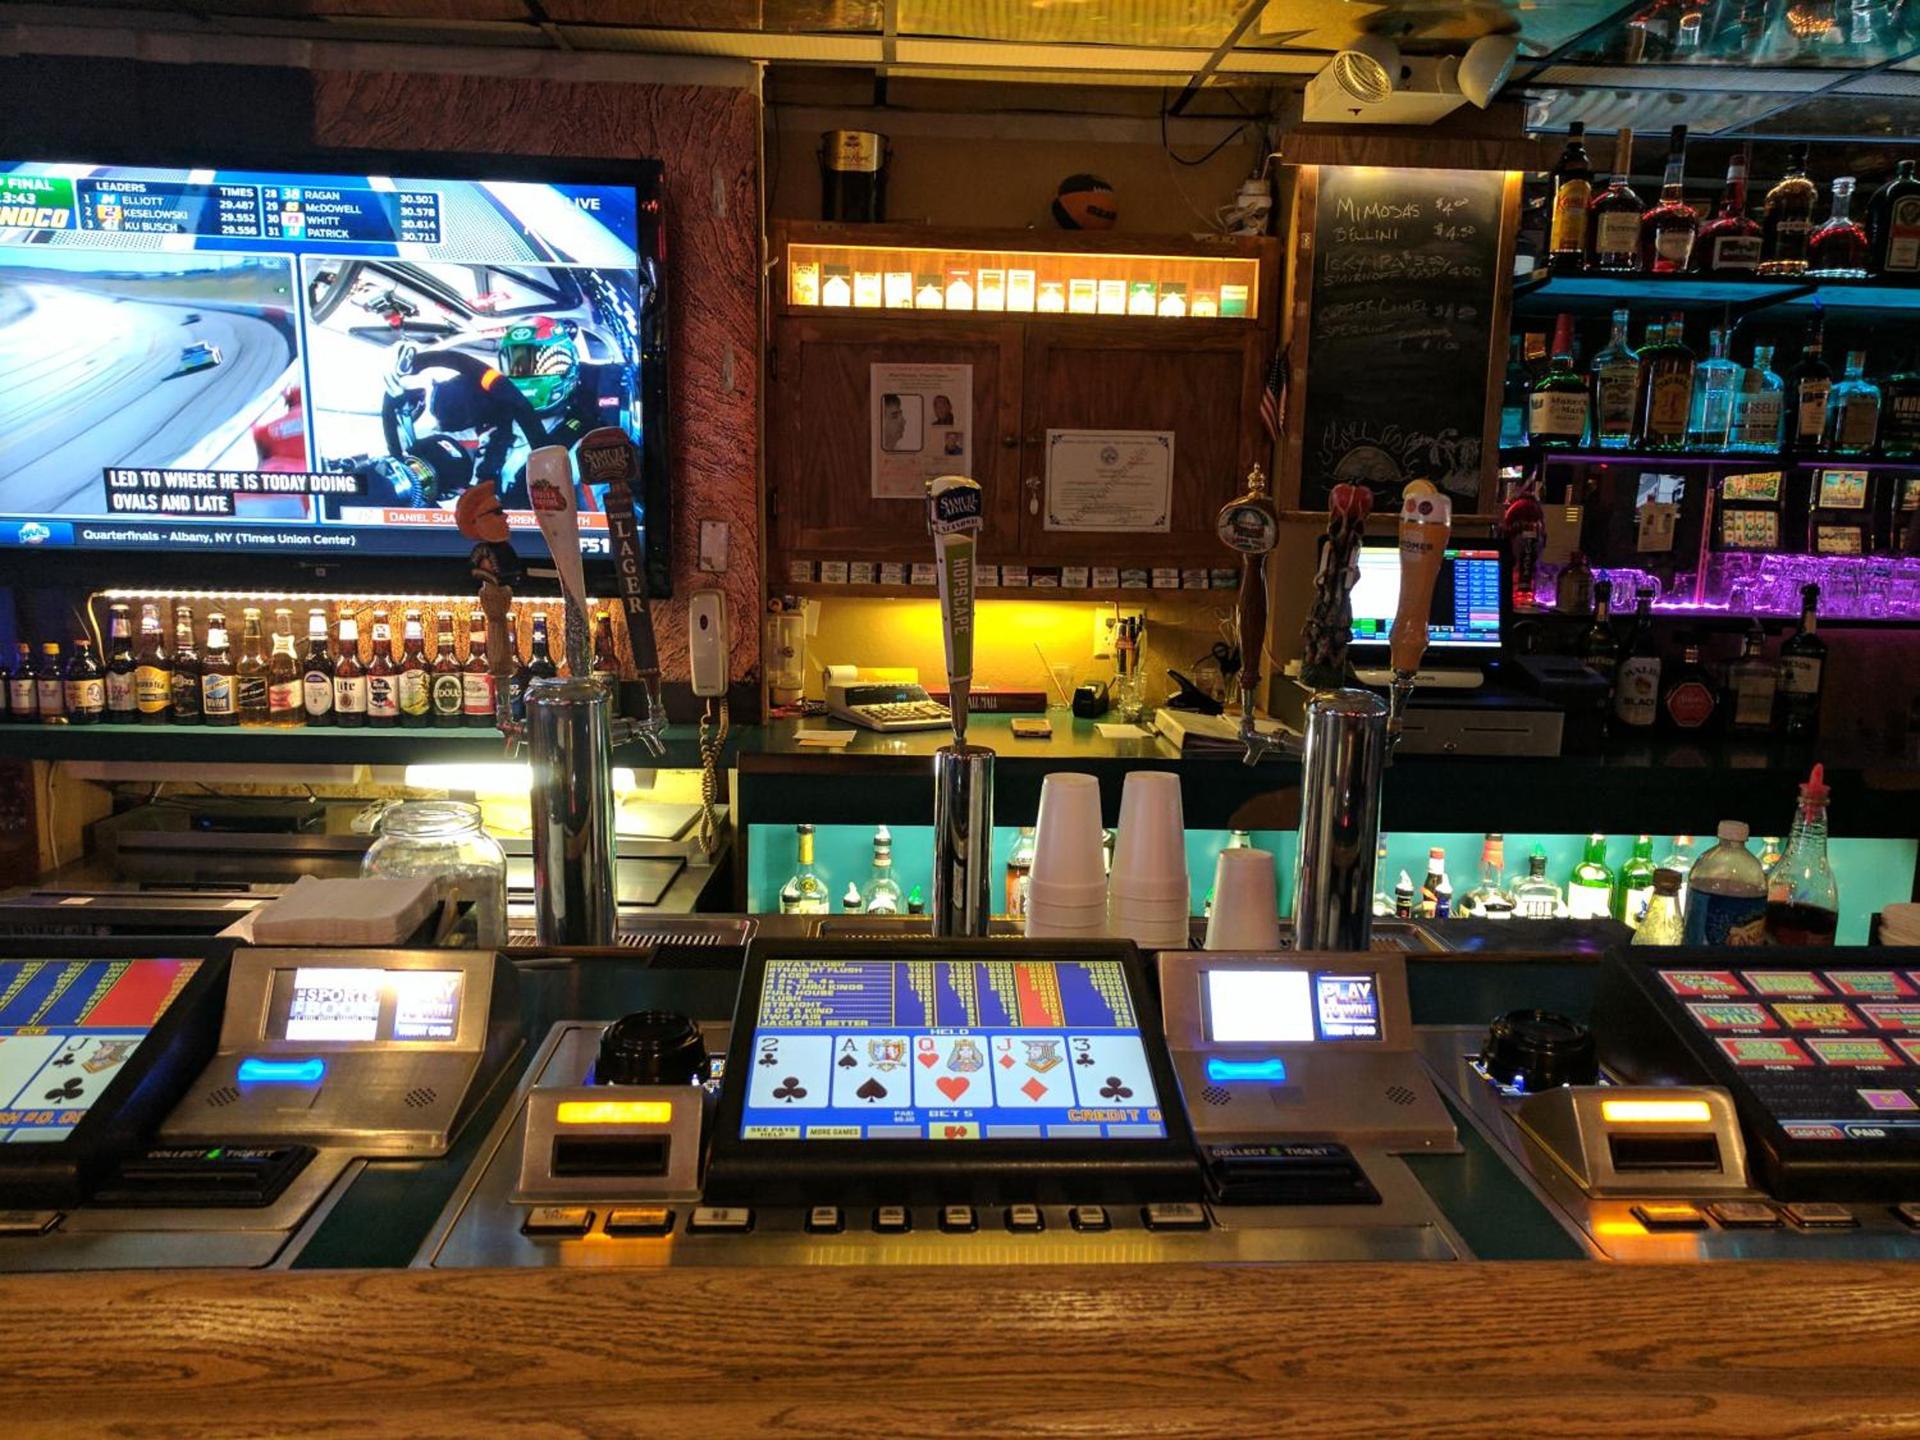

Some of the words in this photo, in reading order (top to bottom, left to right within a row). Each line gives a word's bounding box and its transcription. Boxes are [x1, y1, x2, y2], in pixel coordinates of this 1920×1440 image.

[8, 178, 54, 191] FINAL
[96, 181, 147, 193] LEADERS
[220, 187, 254, 197] TIMES
[121, 195, 164, 205] ELLIOTT
[264, 189, 278, 198] 28
[304, 191, 340, 201] RAGAN
[265, 201, 279, 211] 29
[305, 203, 362, 214] McDOWELL
[1336, 197, 1421, 223] MIMOSAS
[0, 206, 70, 229] NOCO
[123, 209, 189, 220] KESELOWSKI
[266, 214, 280, 224] 30
[306, 216, 340, 226] WHITT
[125, 221, 142, 231] KU
[143, 222, 179, 232] BUSCH
[267, 227, 280, 237] 31
[307, 228, 350, 240] PATRICK
[110, 470, 139, 488] LED
[141, 471, 161, 488] TO
[163, 472, 217, 489] WHERE
[219, 473, 240, 490] HE
[243, 474, 258, 490] IS
[260, 474, 308, 491] TODAY
[310, 475, 357, 492] DOING
[113, 494, 158, 511] OVALS
[161, 495, 192, 511] AND
[194, 495, 229, 512] LATE
[389, 512, 429, 523] DANIEL
[432, 513, 457, 523] SUA
[506, 515, 534, 526] RREN
[577, 516, 591, 526] TH
[83, 529, 160, 543] Quarterfinals
[169, 531, 213, 545] Albany,
[215, 533, 233, 544] NY
[236, 533, 276, 546] (Times
[277, 533, 312, 545] Union
[313, 534, 357, 547] Center)
[580, 538, 611, 554] FS1
[614, 521, 645, 614] LAGER
[952, 558, 969, 635] HOPSCAPE
[1322, 982, 1371, 999] PLAY
[761, 1038, 779, 1051] 2
[841, 1038, 858, 1051] A
[918, 1038, 935, 1051] Q
[997, 1038, 1011, 1051] J
[1073, 1038, 1091, 1051] 3
[1067, 1108, 1140, 1122] CREDIT
[1147, 1109, 1163, 1122] 0
[810, 1128, 831, 1136] MORE
[833, 1128, 859, 1136] GAMES
[1851, 1128, 1886, 1137] PAID
[1212, 1148, 1267, 1157] COLLECT
[1285, 1148, 1329, 1156] TICKET
